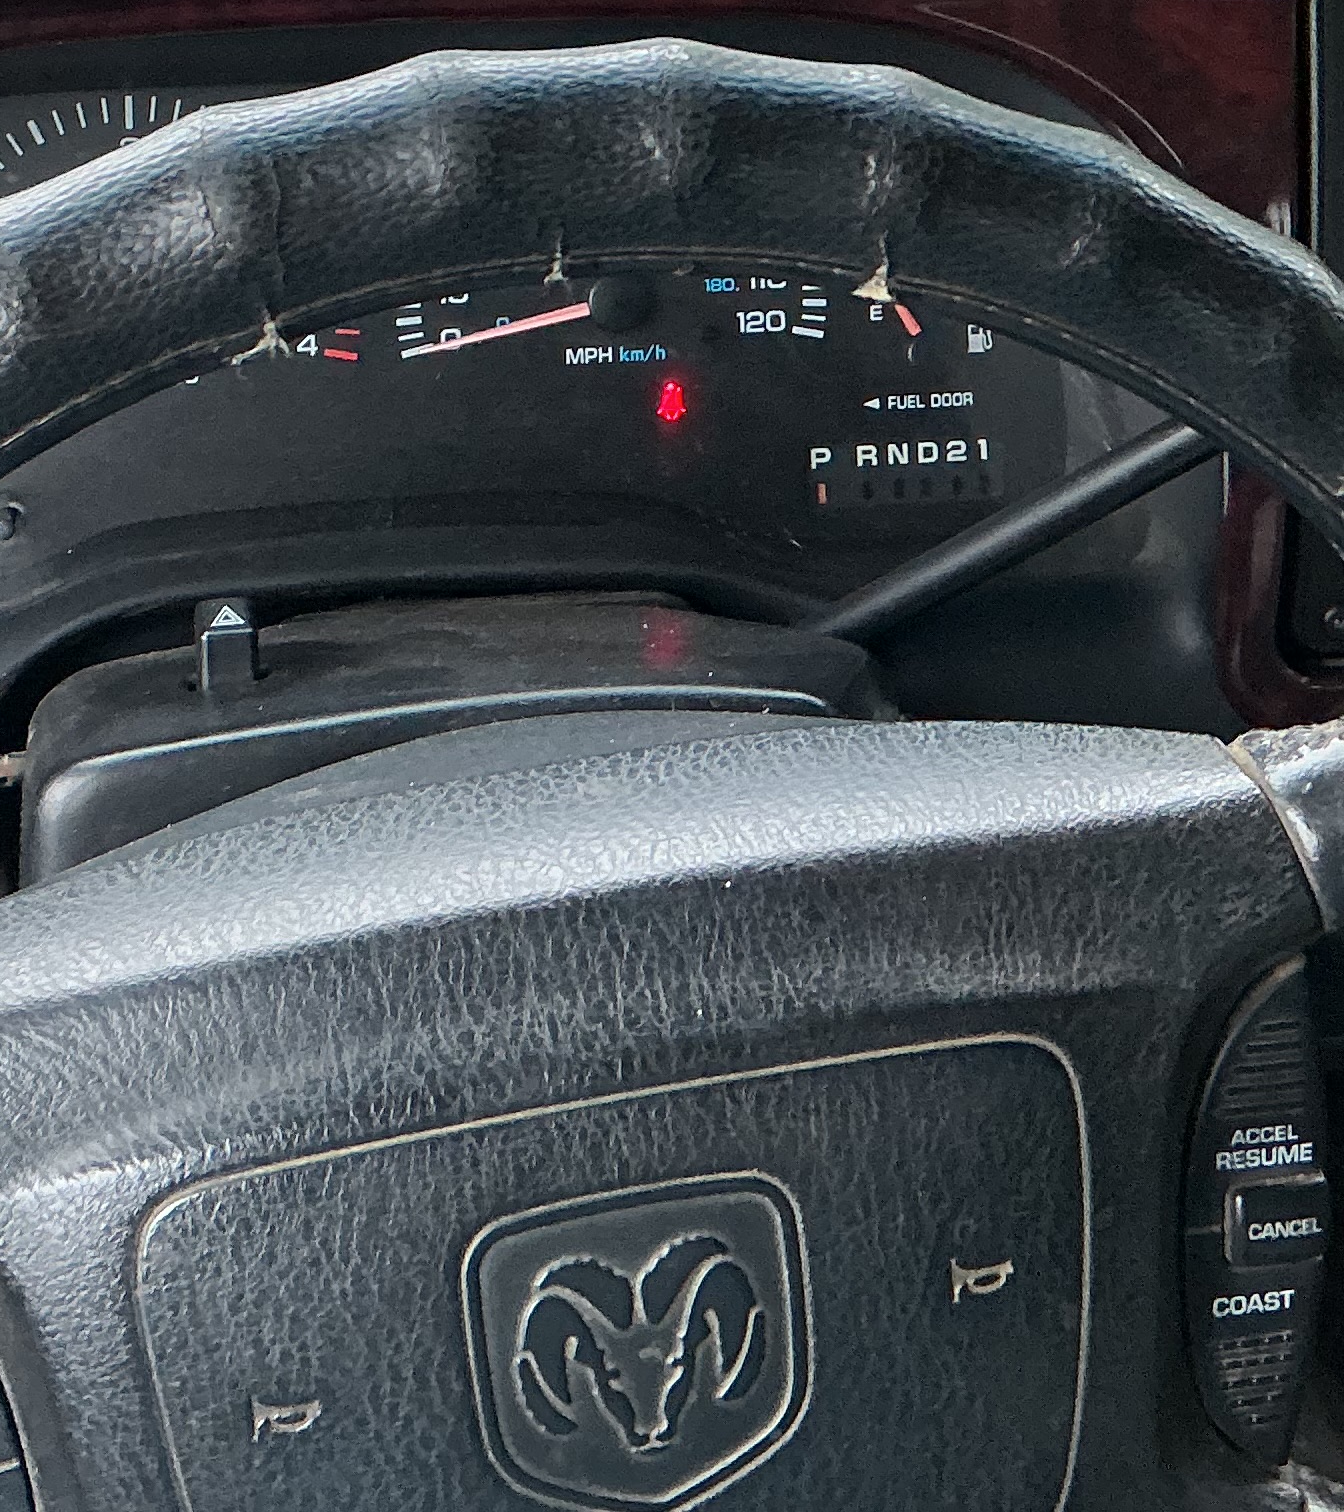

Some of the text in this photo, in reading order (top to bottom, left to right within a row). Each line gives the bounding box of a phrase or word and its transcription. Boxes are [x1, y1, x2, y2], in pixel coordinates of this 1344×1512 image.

[736, 310, 786, 334] 120
[869, 304, 884, 322] E
[296, 333, 319, 357] 4
[565, 344, 667, 365] MPH km/h
[887, 391, 974, 410] FUEL DOOR
[809, 447, 832, 470] P
[1231, 1124, 1299, 1148] ACCEL
[1215, 1142, 1314, 1171] RESUME
[1247, 1217, 1323, 1241] CANCEL
[1212, 1289, 1296, 1319] COAST
